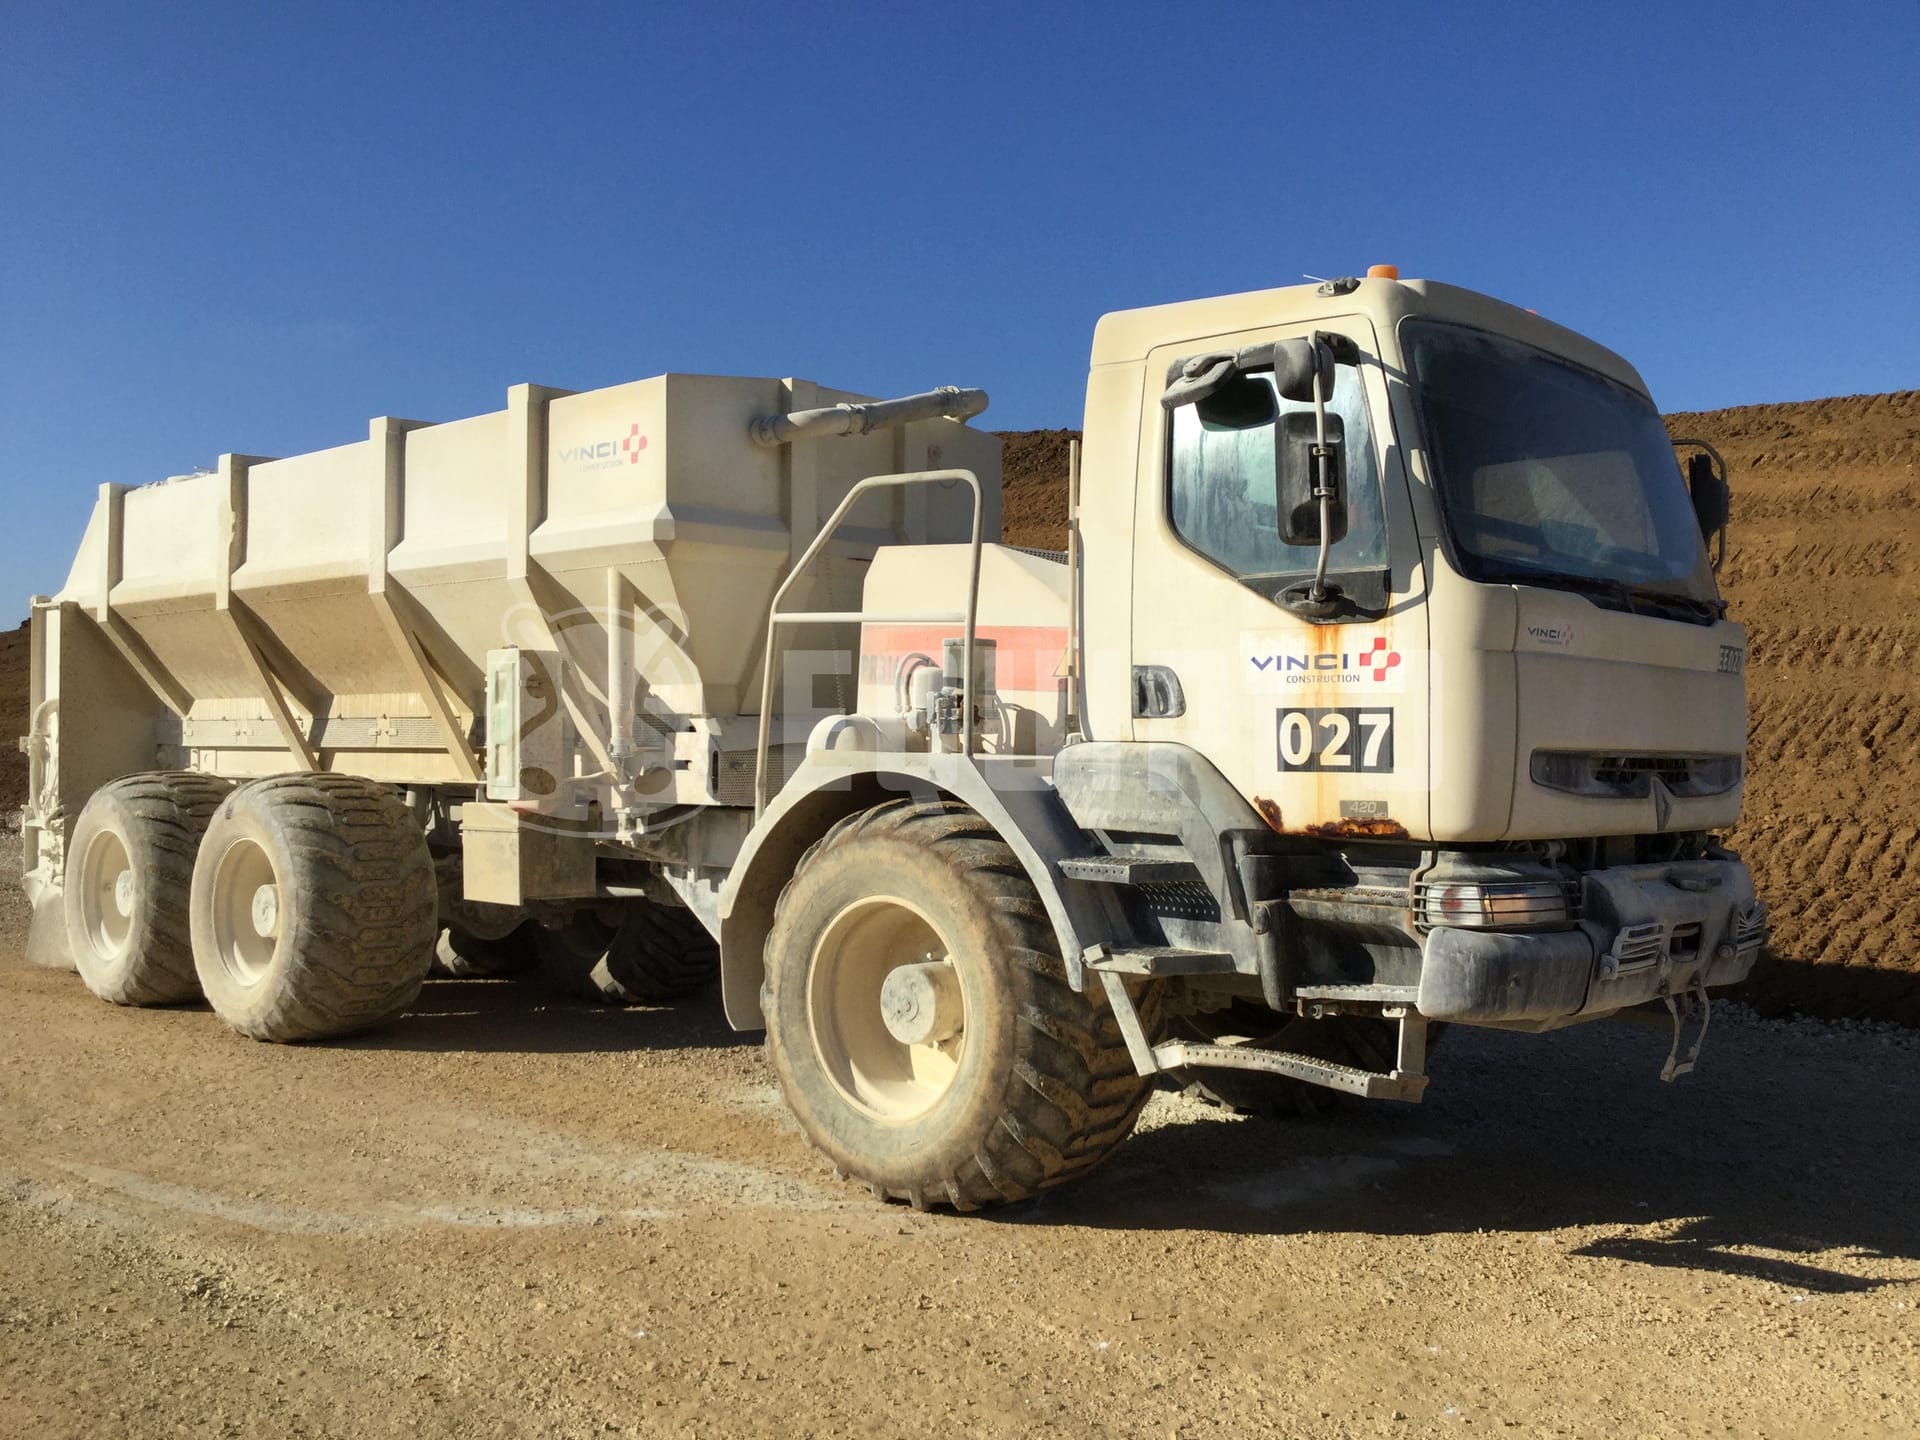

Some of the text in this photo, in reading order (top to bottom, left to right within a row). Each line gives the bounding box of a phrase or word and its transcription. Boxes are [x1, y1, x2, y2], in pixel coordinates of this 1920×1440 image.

[558, 440, 617, 463] VINCI
[1527, 626, 1561, 639] VINCI
[1250, 653, 1349, 671] VINCI
[1286, 674, 1360, 684] CONSTRUCTION
[1279, 713, 1391, 767] 027
[1350, 801, 1377, 813] 420
